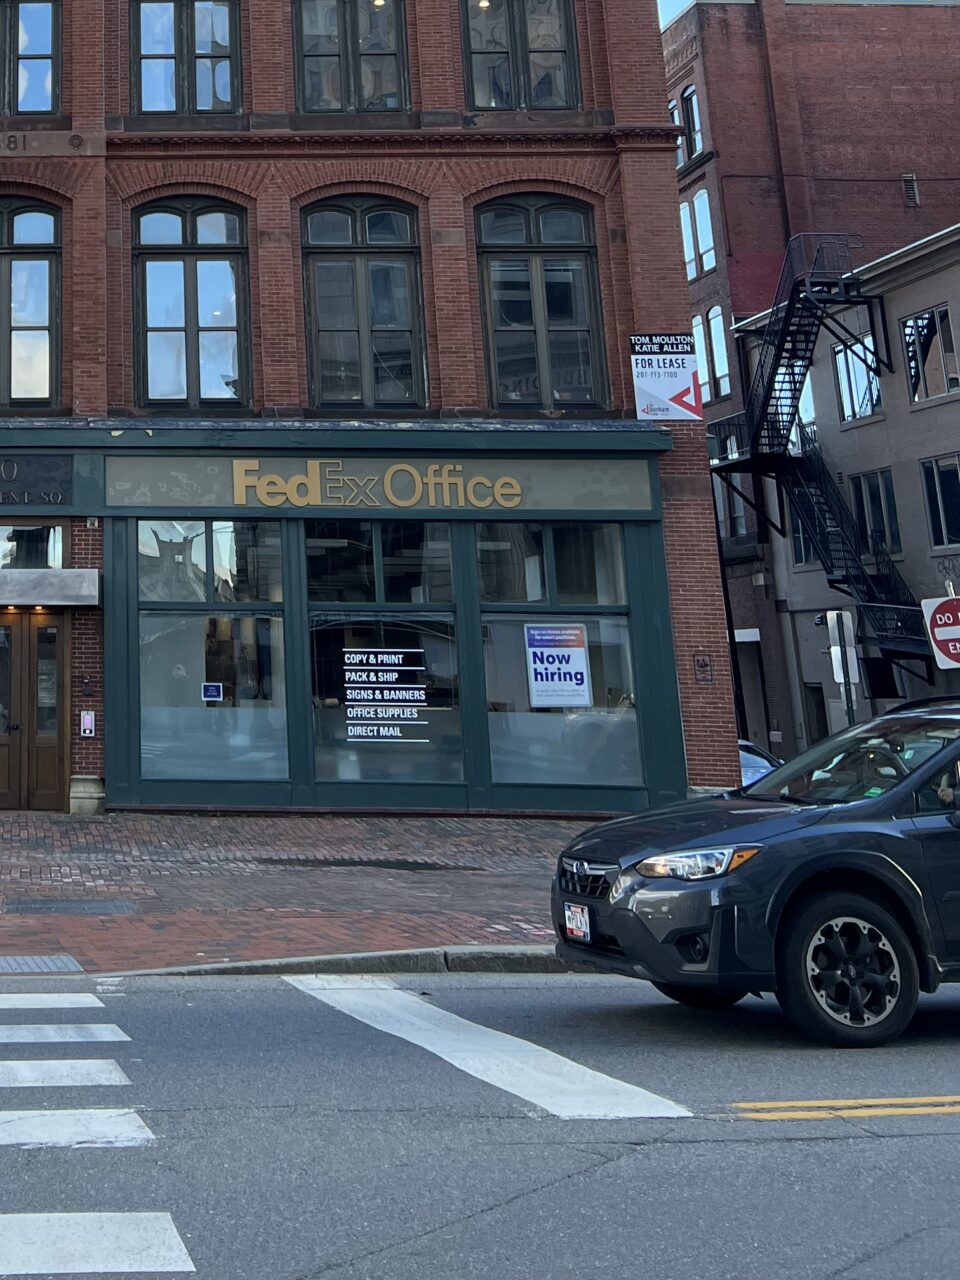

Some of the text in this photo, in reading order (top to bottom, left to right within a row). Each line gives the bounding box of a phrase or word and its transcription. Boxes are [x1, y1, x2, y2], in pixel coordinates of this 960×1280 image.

[635, 344, 691, 352] KATIE ALLEN
[635, 358, 687, 369] FOR LEASE
[636, 371, 678, 379] 207-773-7100
[935, 613, 953, 625] DO
[344, 653, 404, 664] COPY & PRINT
[532, 651, 571, 665] Now
[345, 671, 399, 682] PACK & SHIP
[533, 666, 585, 686] hiring
[346, 689, 426, 700] SIGNS & BANNERS
[347, 707, 418, 718] OFFICE SUPPLIES
[348, 726, 402, 736] DIRECT MAIL
